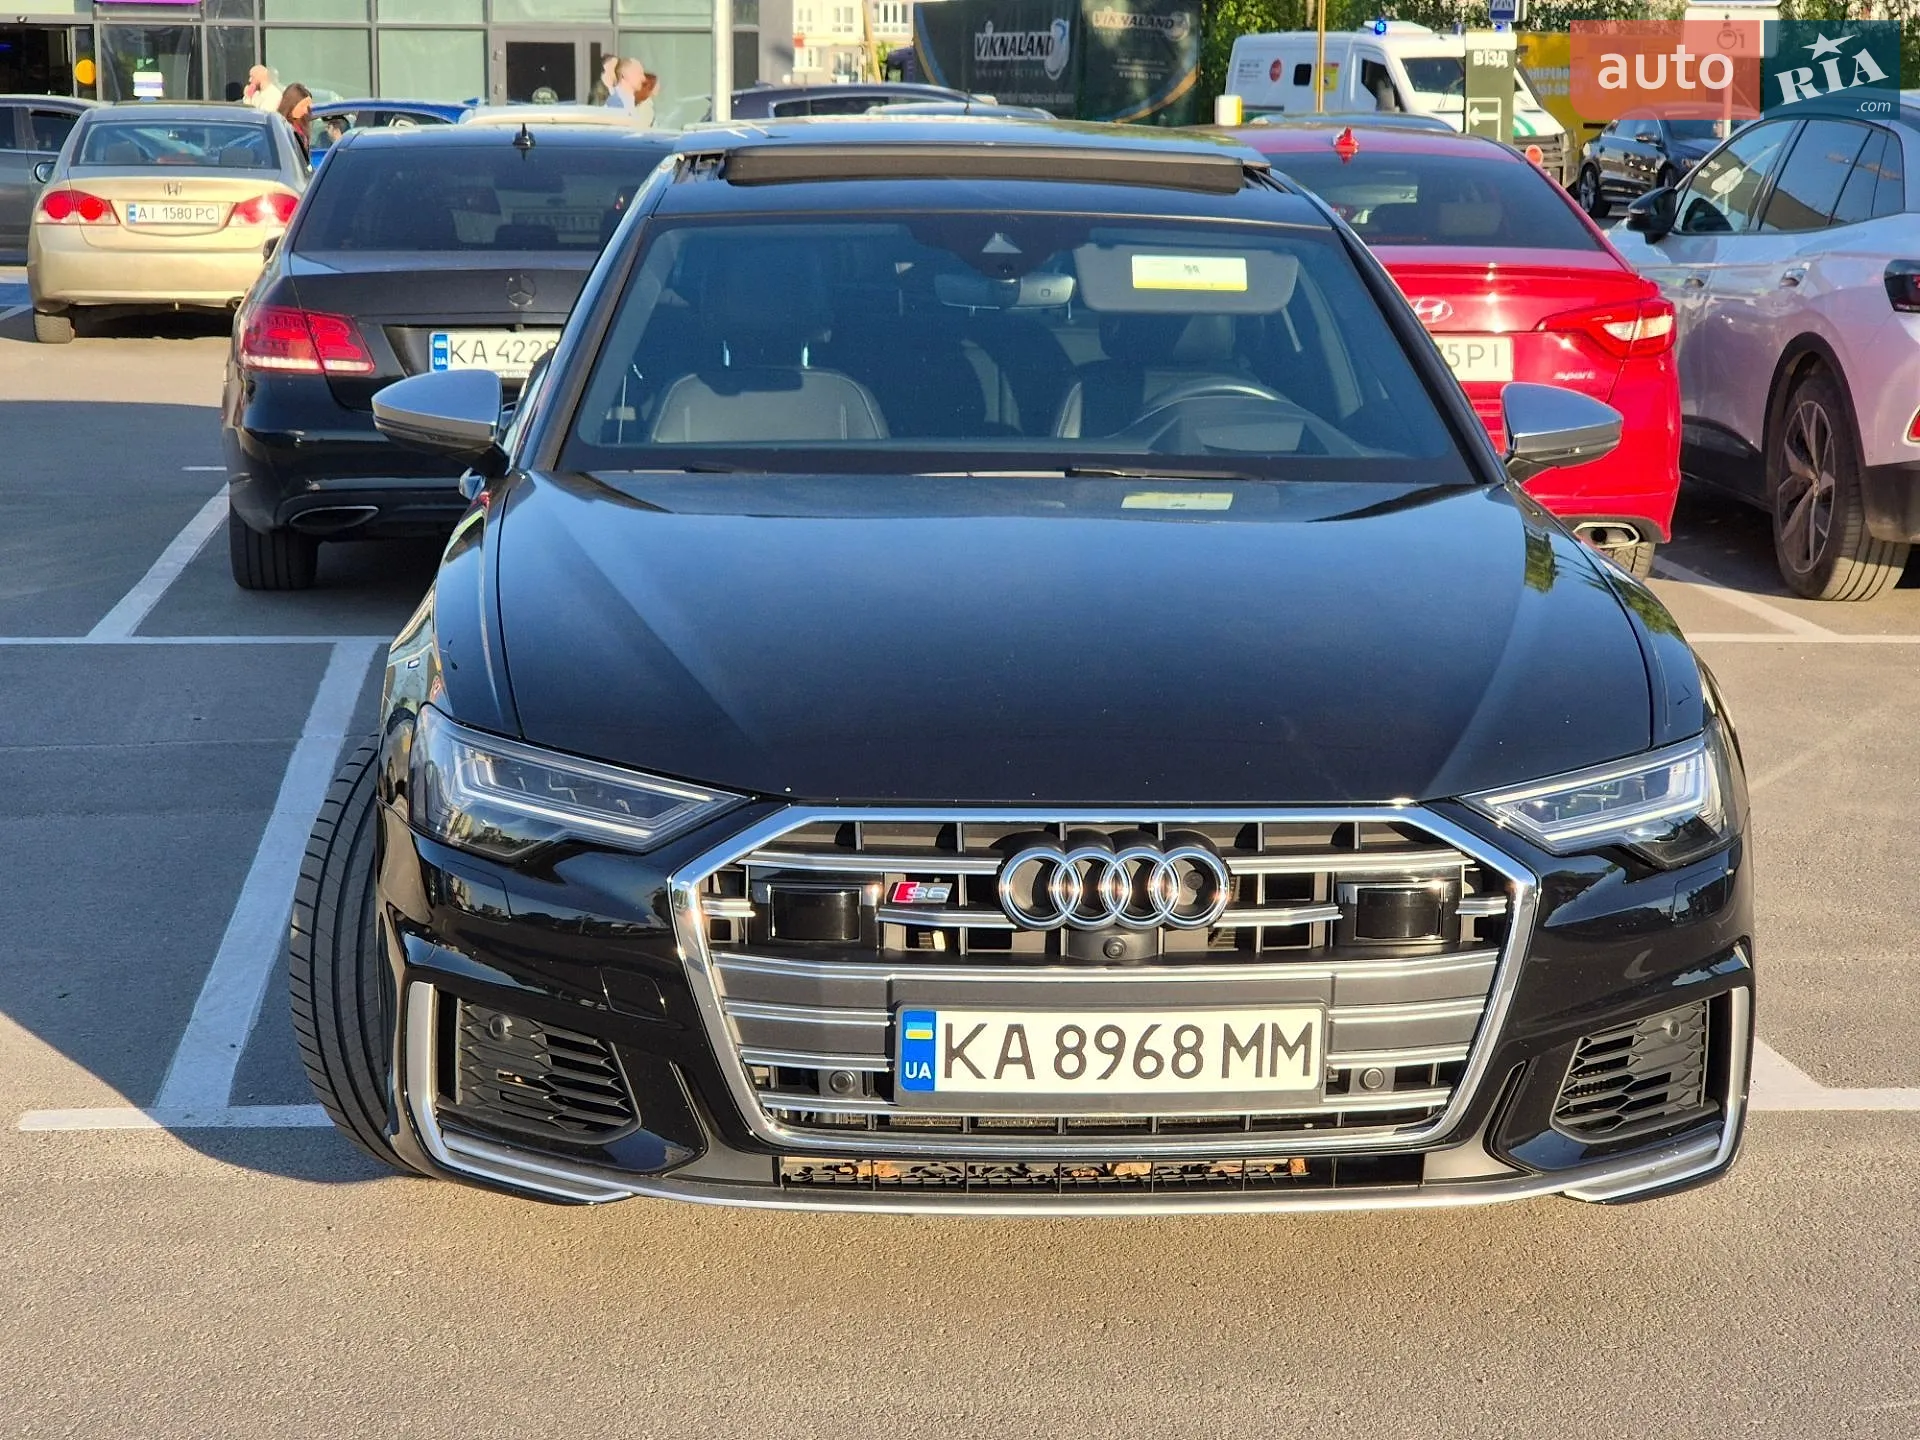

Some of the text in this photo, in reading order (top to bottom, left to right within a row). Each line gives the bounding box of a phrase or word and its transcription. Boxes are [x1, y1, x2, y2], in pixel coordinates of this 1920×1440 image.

[976, 34, 1055, 57] VIKNALAND
[138, 207, 215, 220] AI 1580 PC
[450, 340, 488, 364] KA
[1553, 371, 1596, 381] sport
[902, 885, 951, 900] S6
[944, 1022, 1313, 1081] KA 8968 MM
[905, 1062, 932, 1080] UA
